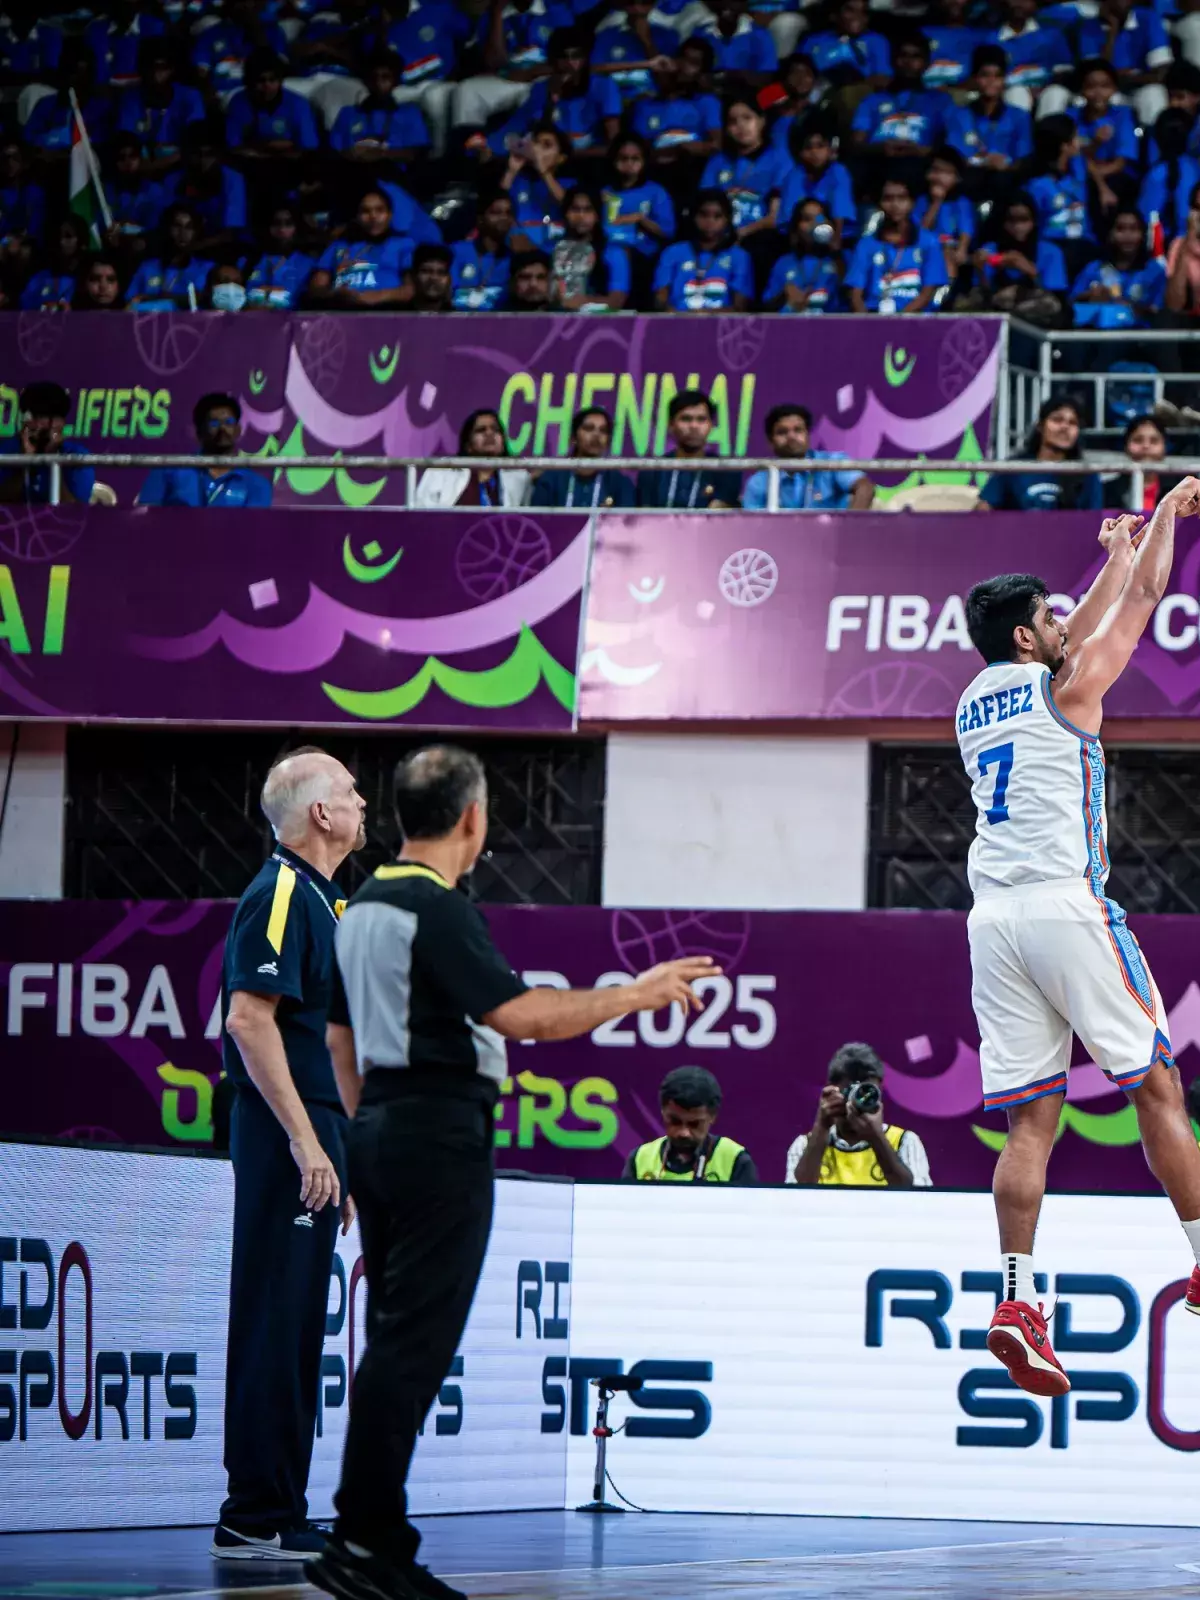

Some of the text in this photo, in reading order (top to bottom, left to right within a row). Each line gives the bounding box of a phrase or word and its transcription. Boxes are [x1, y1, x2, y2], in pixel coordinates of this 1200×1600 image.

[0, 384, 172, 438] QIFIERS
[826, 594, 974, 652] FIBA
[977, 742, 1015, 826] 7
[7, 962, 186, 1039] FIBA
[591, 971, 777, 1050] 2025
